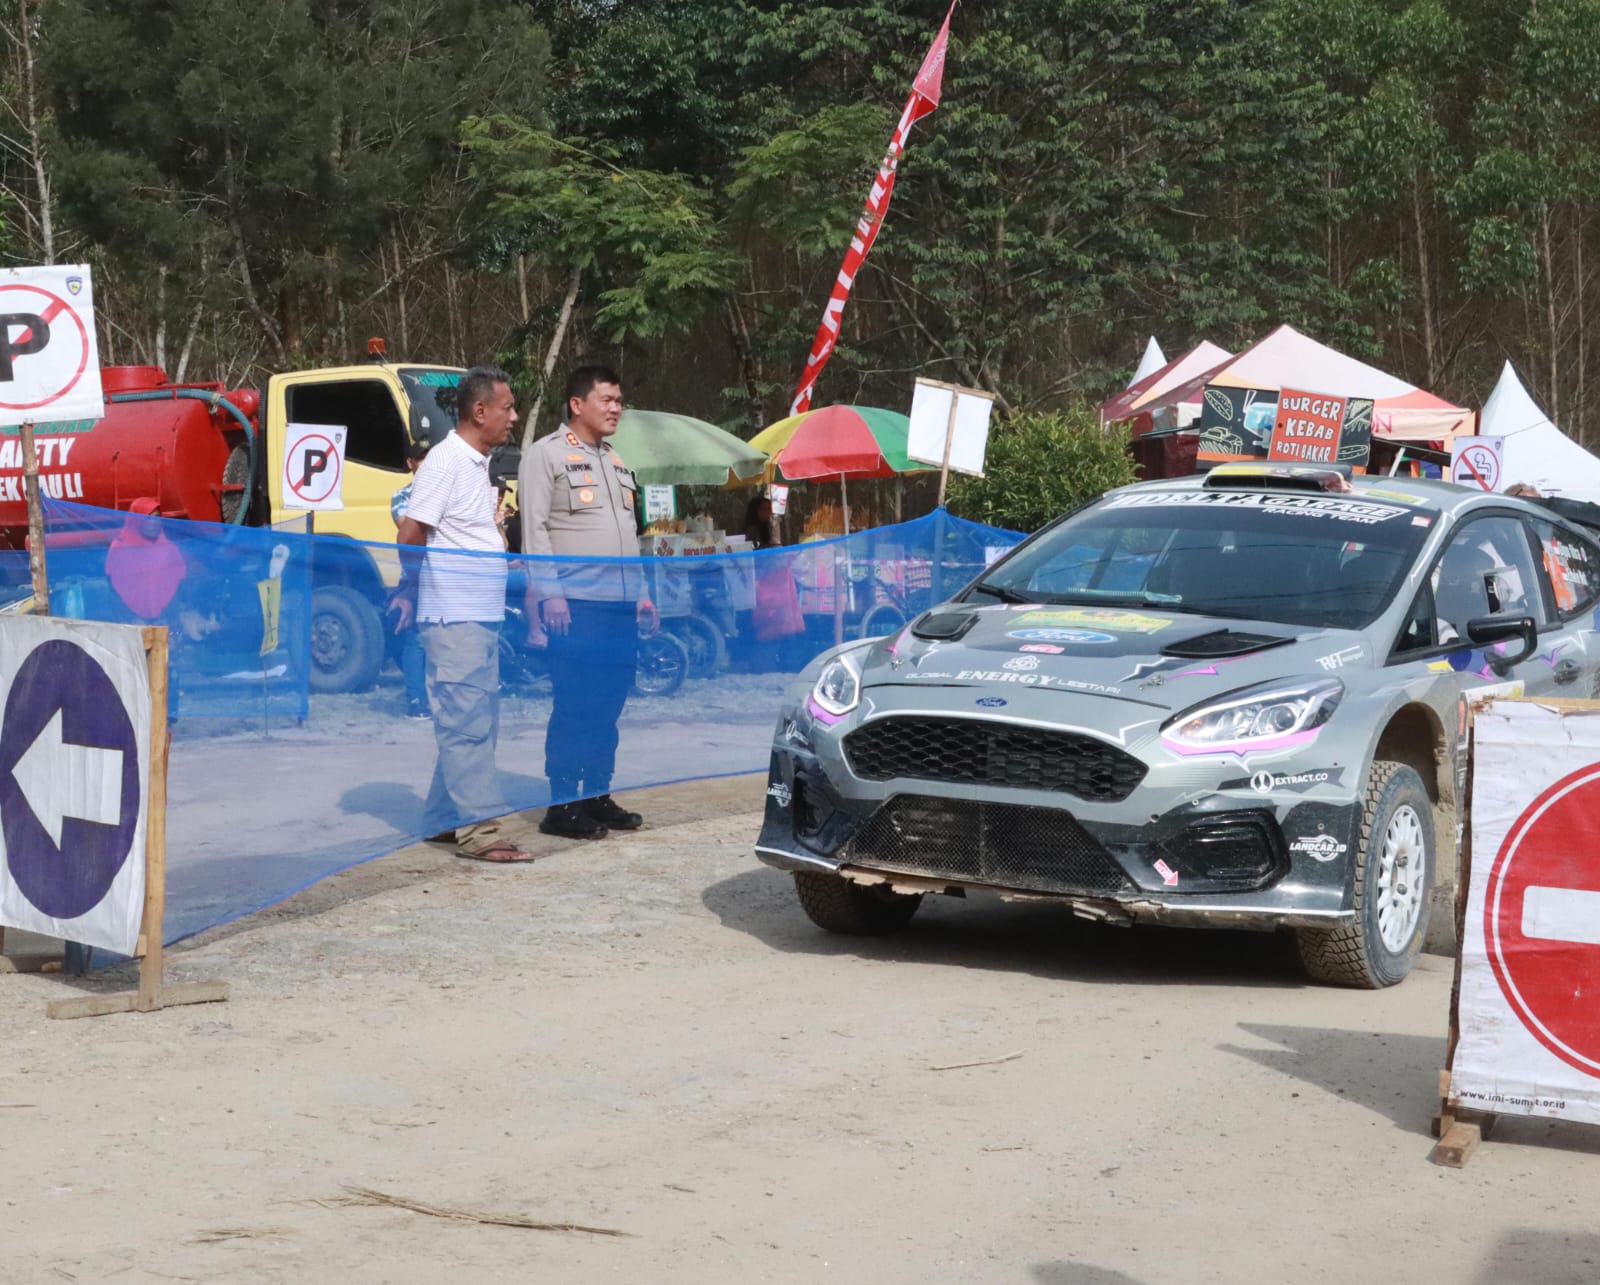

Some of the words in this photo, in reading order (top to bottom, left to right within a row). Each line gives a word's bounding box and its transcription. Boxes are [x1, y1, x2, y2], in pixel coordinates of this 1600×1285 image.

[0, 313, 50, 381] P
[1282, 397, 1341, 421] BURGER
[1285, 418, 1334, 440] KEBAB
[1276, 441, 1300, 456] ROTI
[1301, 444, 1331, 462] BAKAR
[303, 449, 327, 486] P
[22, 472, 84, 499] AULI
[1262, 508, 1323, 518] RACING
[1330, 513, 1379, 525] TEAM
[1264, 497, 1398, 517] GARAGE
[955, 670, 1059, 686] ENERGY
[1058, 679, 1121, 694] LESTARI
[1275, 772, 1328, 785] EXTRACT.CO
[1289, 842, 1347, 852] LANDCAR.ID
